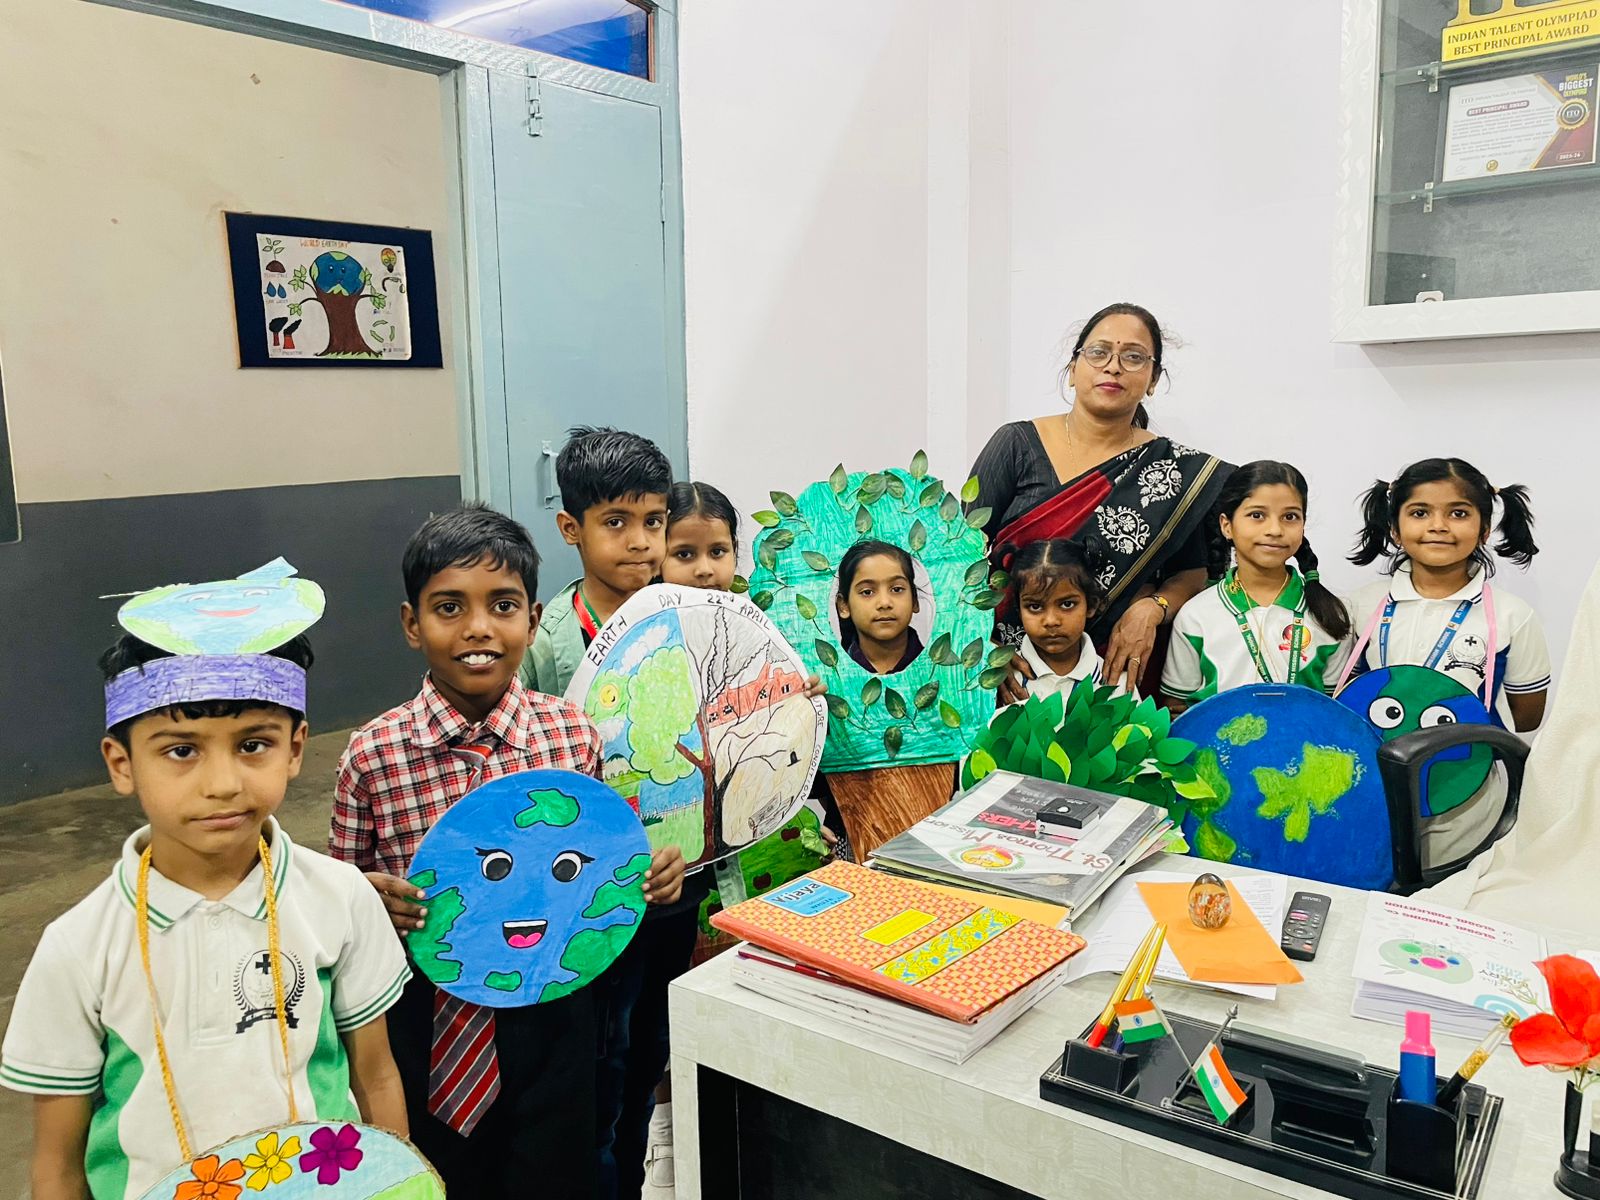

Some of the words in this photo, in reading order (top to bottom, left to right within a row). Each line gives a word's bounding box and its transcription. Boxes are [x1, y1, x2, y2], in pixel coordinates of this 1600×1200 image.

[1447, 29, 1487, 44] INDIAN
[1489, 21, 1533, 36] TALENT
[1536, 9, 1597, 28] OLYMPIAD
[1454, 43, 1481, 56] BEST
[1483, 34, 1543, 51] PRINCIPAL
[1545, 24, 1589, 40] AWARD
[1558, 78, 1594, 92] BIGGEST
[588, 616, 628, 666] EARTH
[658, 593, 682, 608] DAY
[707, 593, 735, 604] 22nd
[740, 603, 772, 630] APRIL
[148, 677, 206, 706] SAVE
[234, 676, 290, 701] EARTH
[813, 696, 824, 727] UTURE
[800, 745, 821, 801] CONDITION
[923, 817, 993, 842] Mission
[997, 833, 1074, 861] Thomas
[772, 882, 821, 903] Vijaya
[1384, 901, 1452, 920] PUBLICATION
[1402, 912, 1451, 927] TRADING
[1455, 917, 1496, 932] GLOBAL
[1455, 924, 1496, 940] GLOBAL
